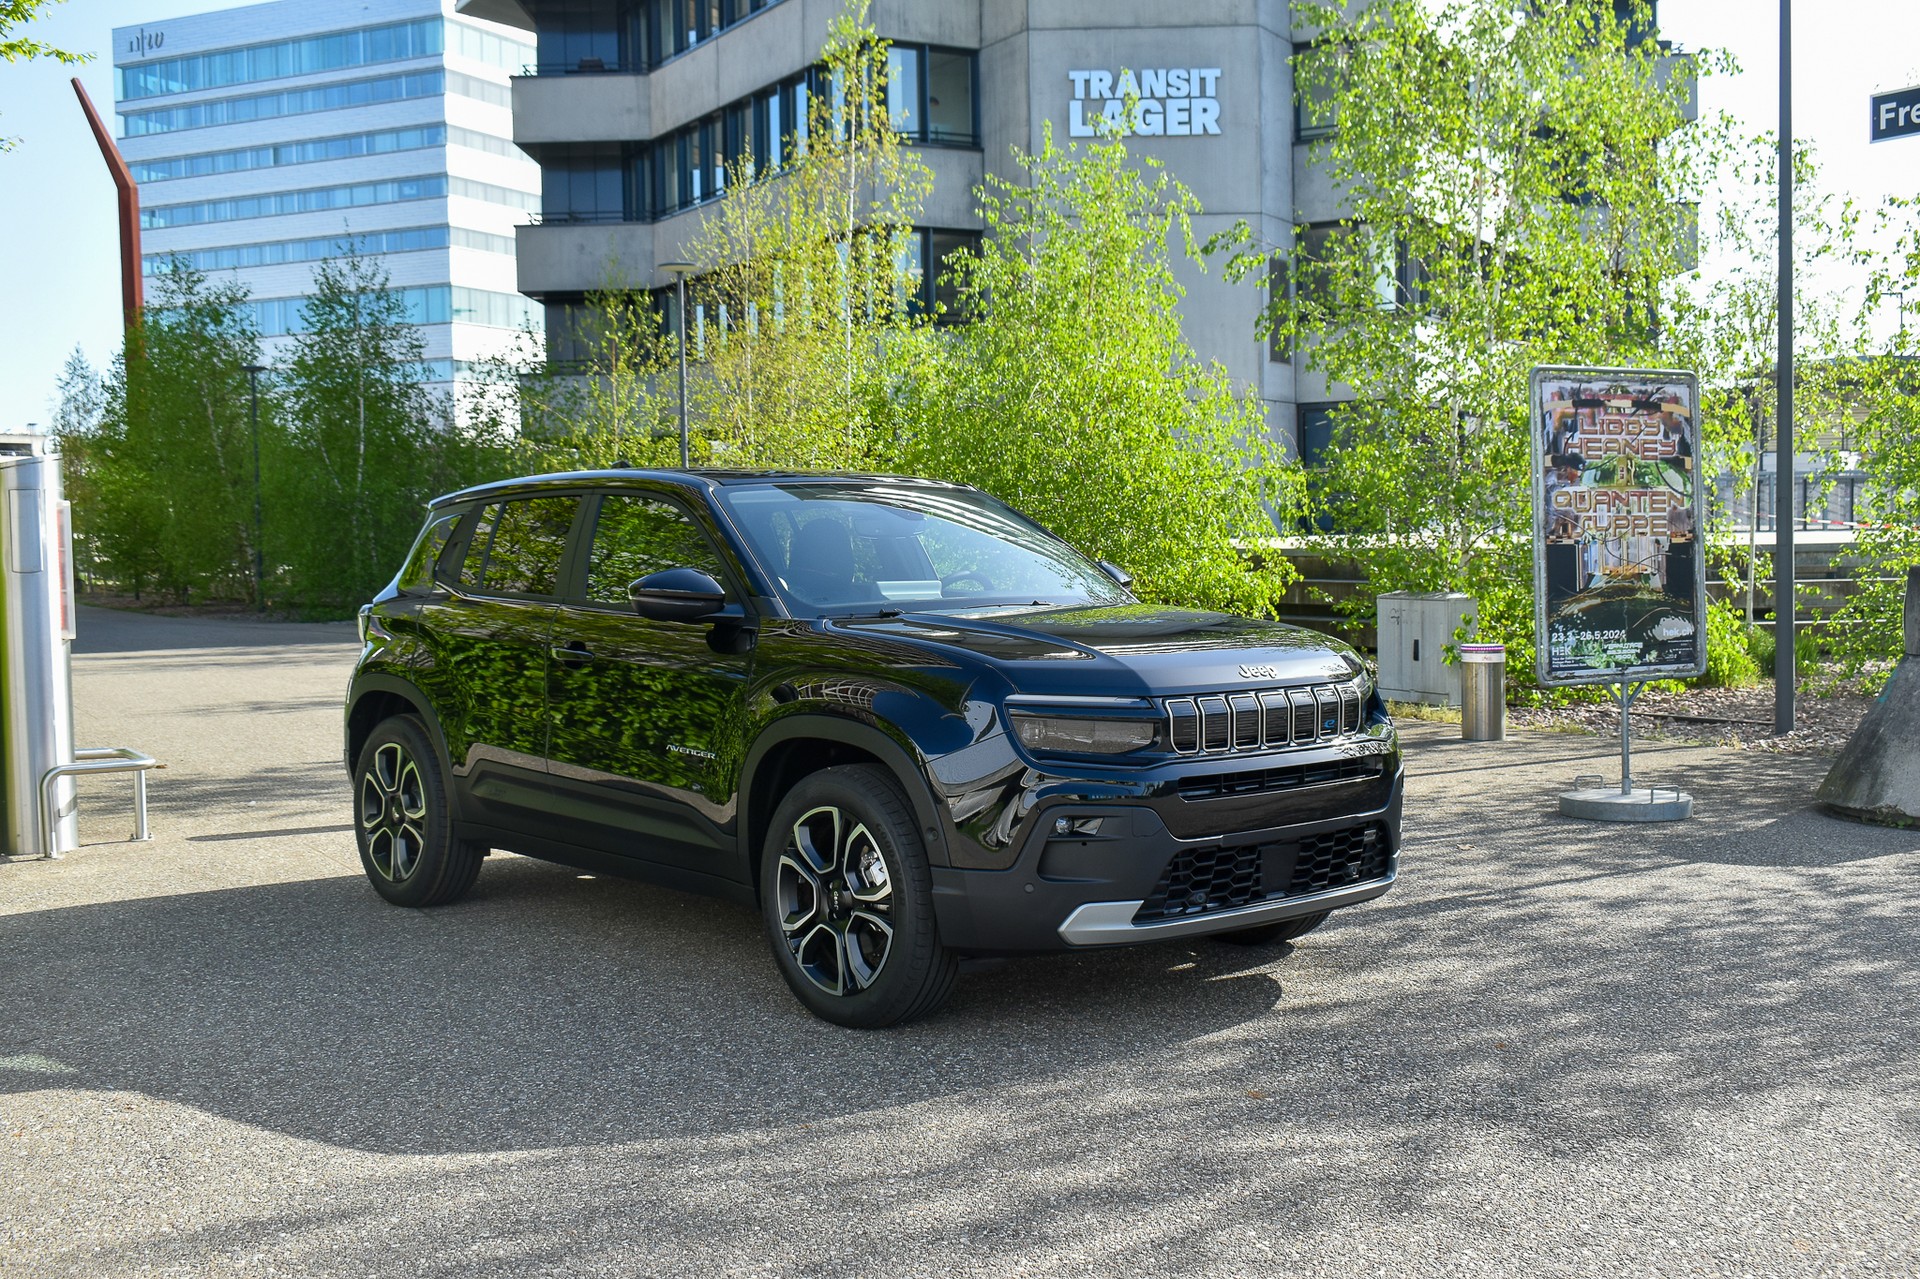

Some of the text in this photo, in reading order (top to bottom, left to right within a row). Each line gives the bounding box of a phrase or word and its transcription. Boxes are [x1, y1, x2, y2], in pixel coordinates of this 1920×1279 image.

[1069, 68, 1221, 99] TRANSIT
[1069, 98, 1222, 137] LAGER
[1579, 418, 1661, 436] LIBBY
[1564, 438, 1677, 460] HEANEY
[1553, 490, 1686, 513] QUANTEN
[1573, 515, 1667, 537] SUPPE
[1662, 627, 1693, 636] hek.ch
[1238, 664, 1277, 679] Jeep
[666, 744, 716, 760] AVENGER
